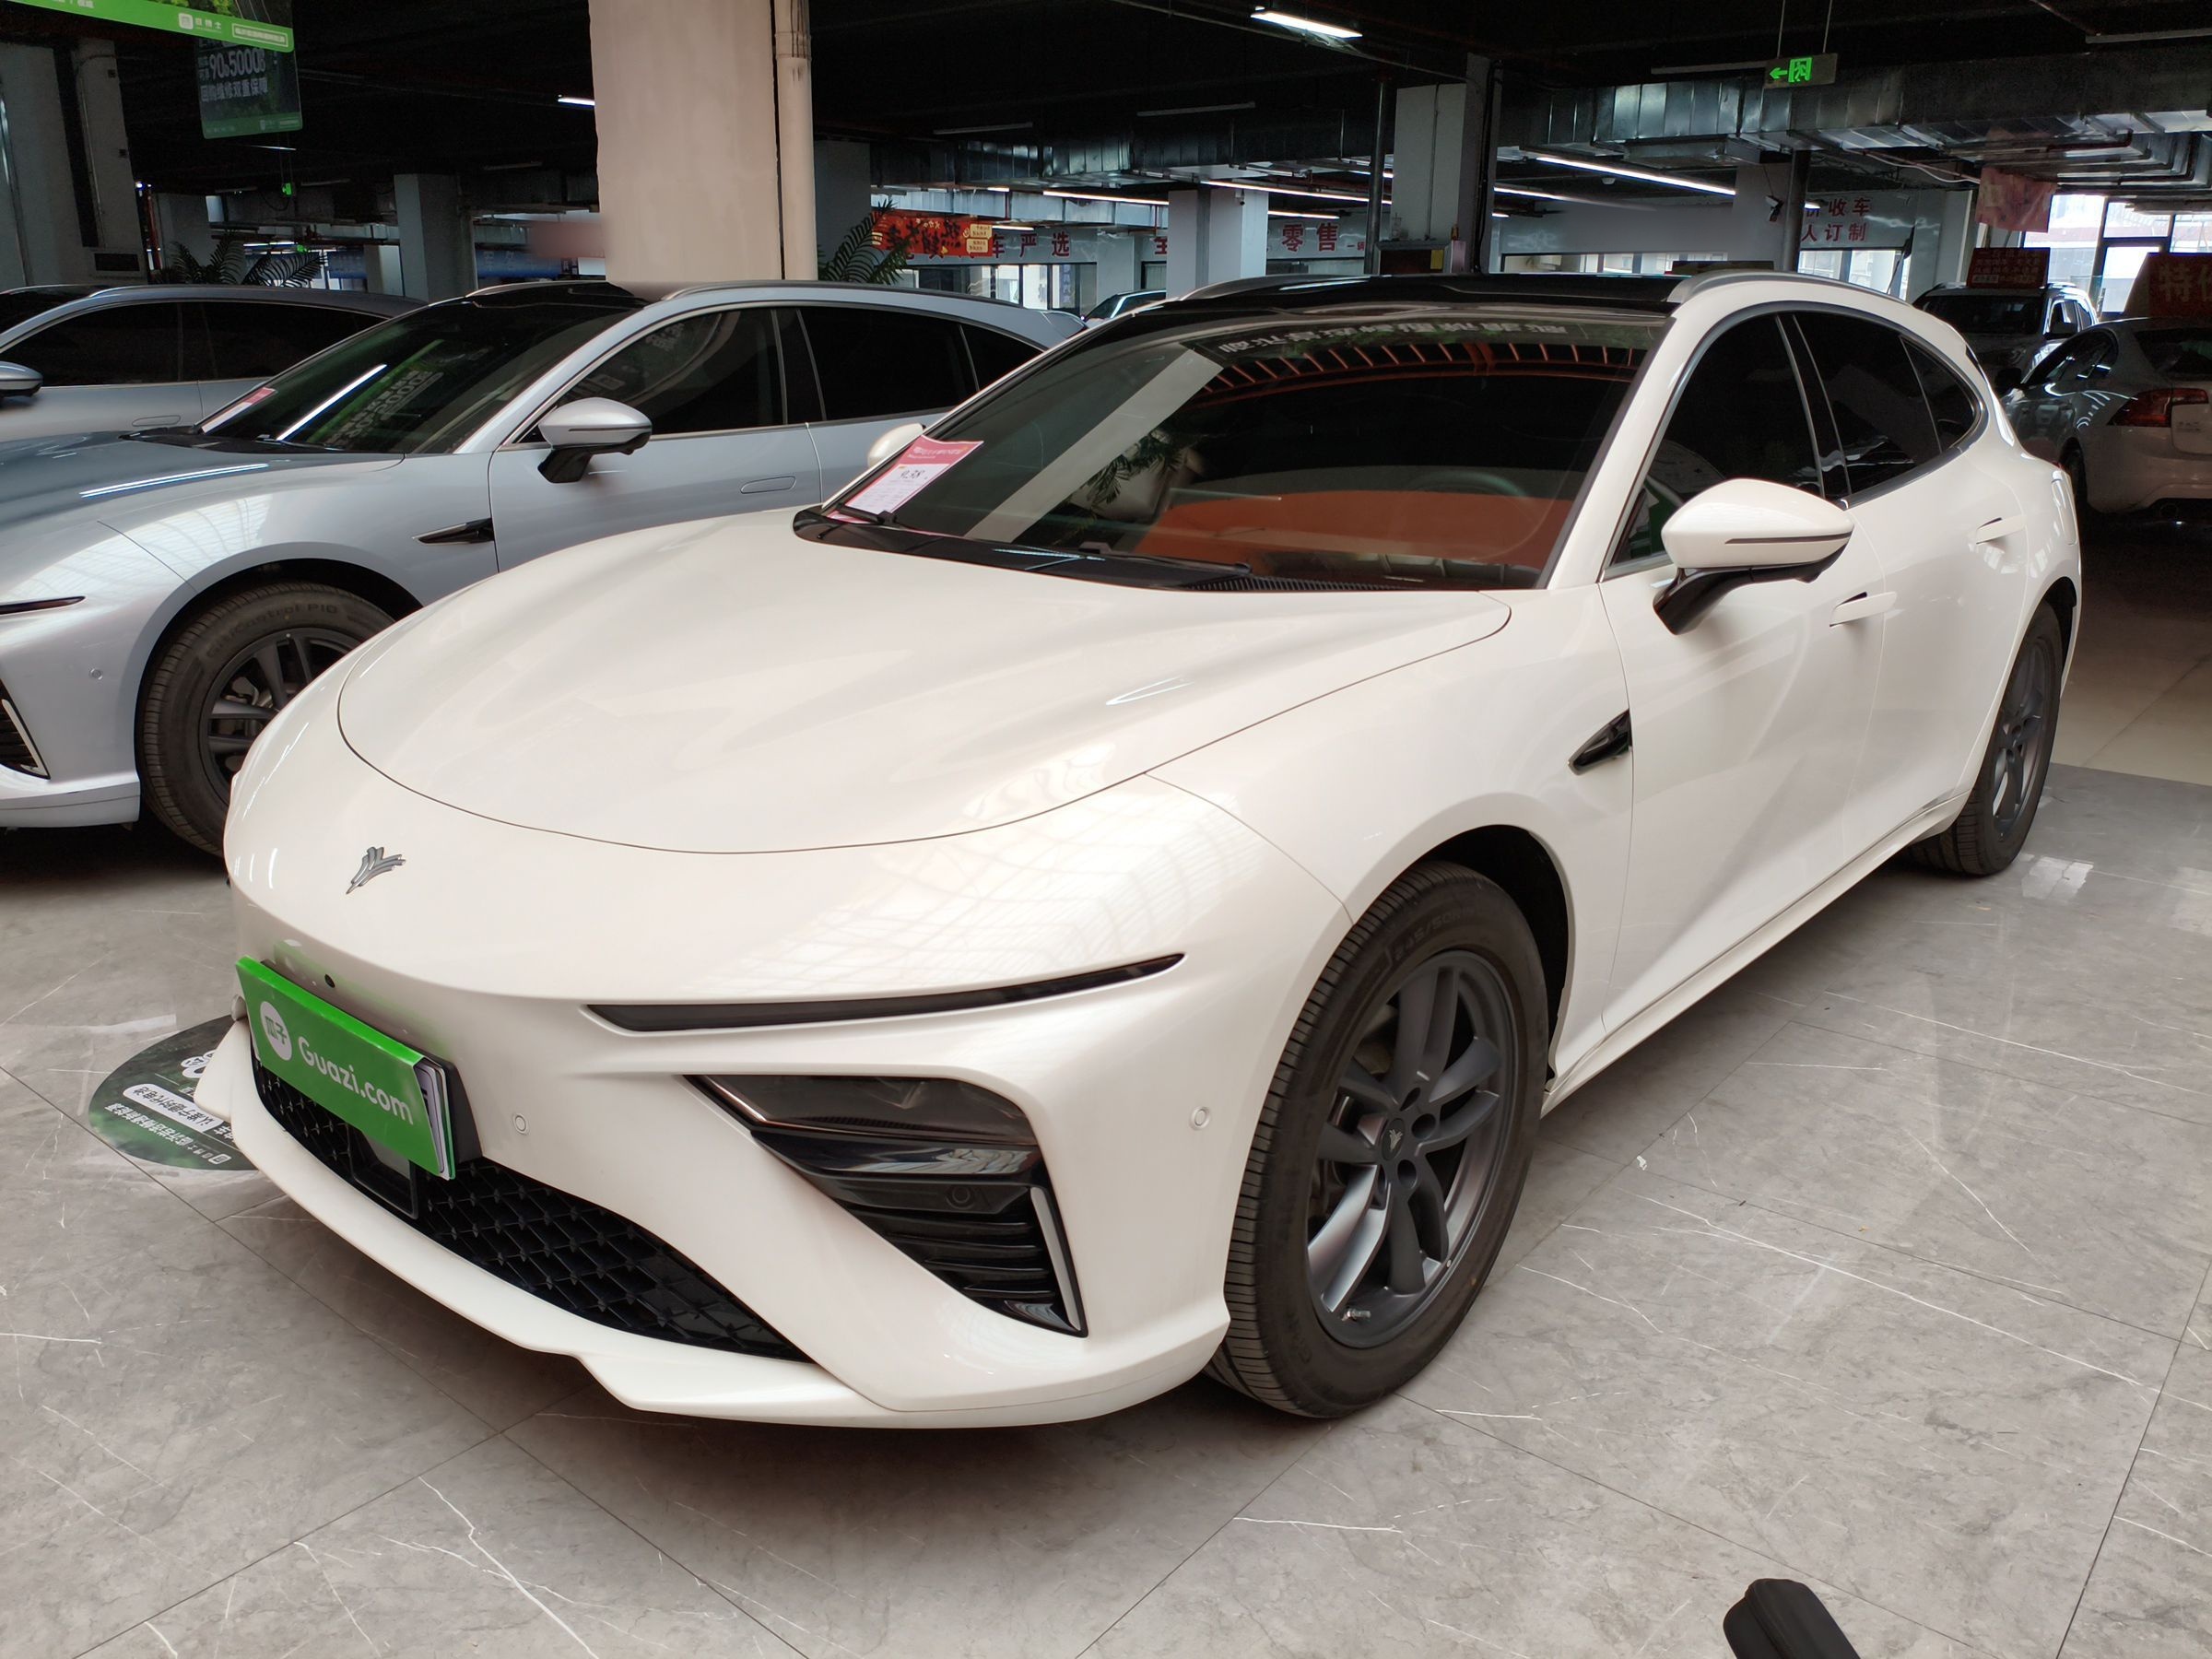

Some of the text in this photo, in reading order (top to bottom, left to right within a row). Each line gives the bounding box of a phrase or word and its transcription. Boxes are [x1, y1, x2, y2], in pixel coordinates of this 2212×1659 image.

[1282, 222, 1338, 252] 零售
[265, 1016, 288, 1045] 瓜子
[298, 1036, 414, 1125] Guazi.com
